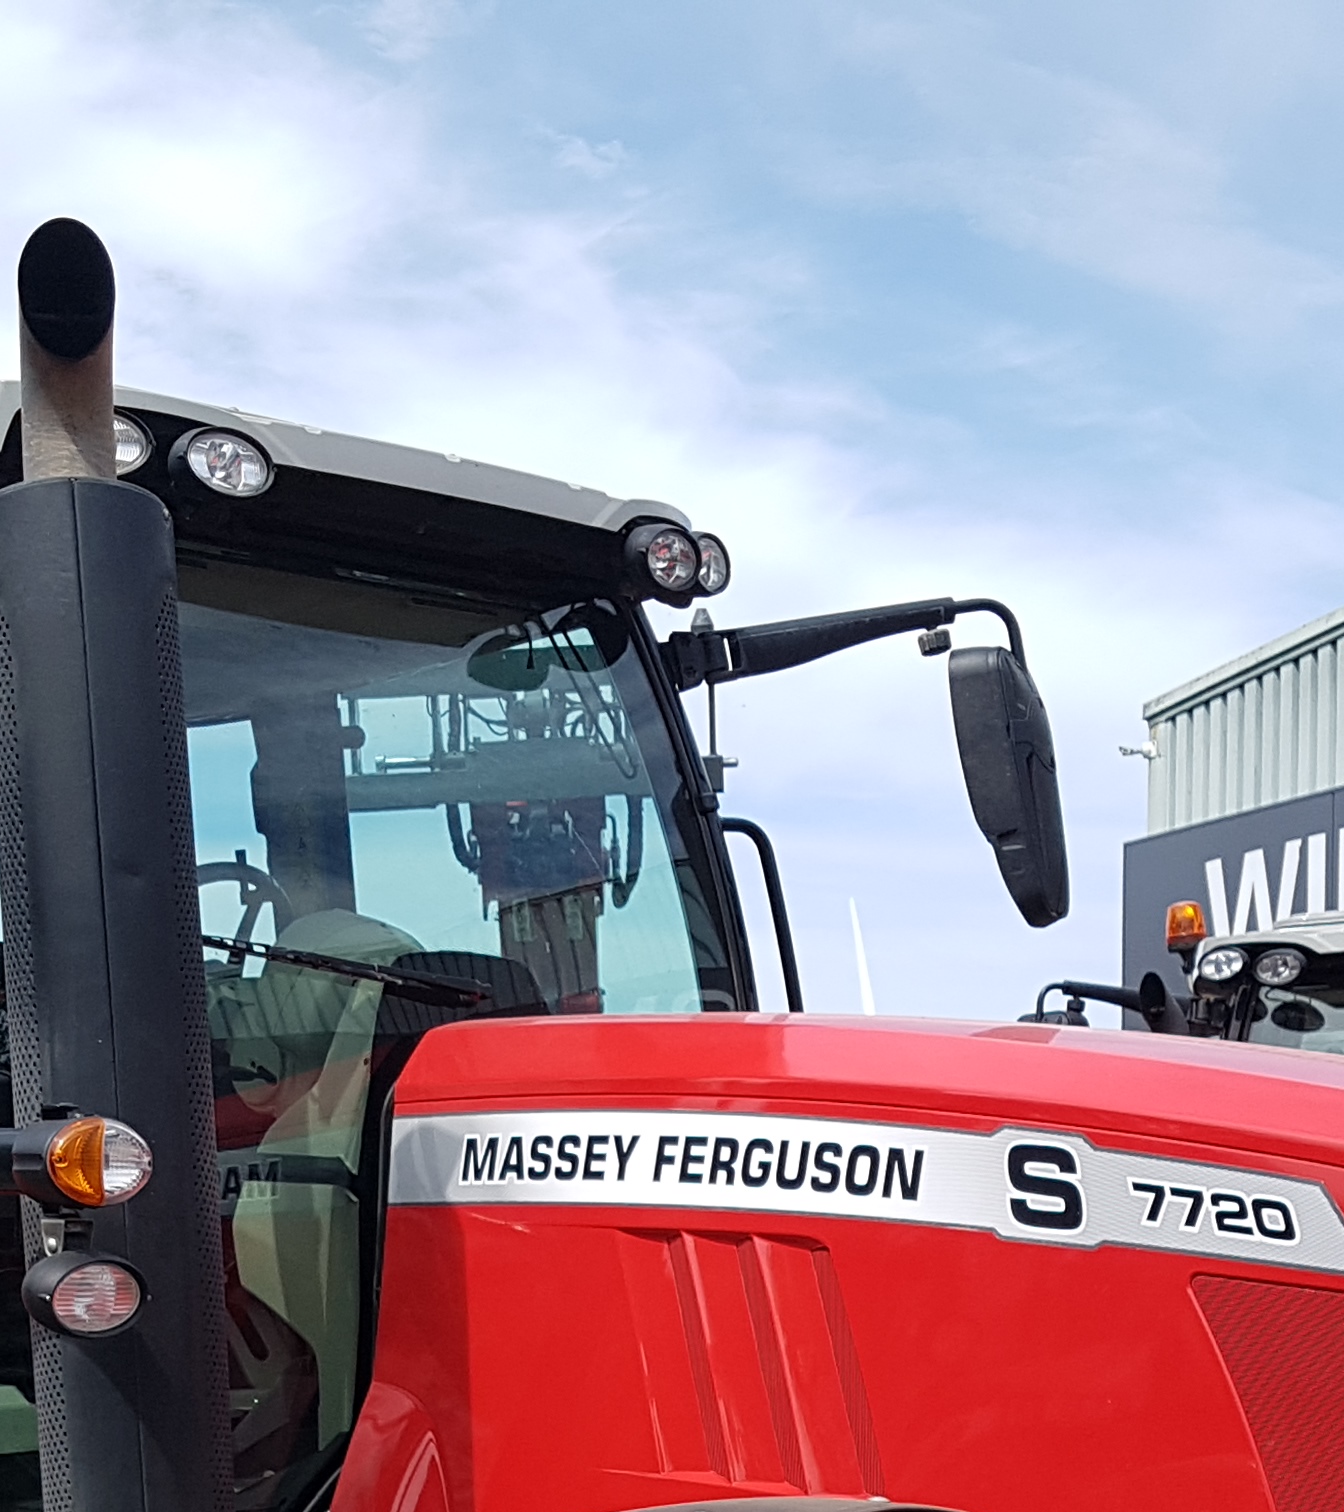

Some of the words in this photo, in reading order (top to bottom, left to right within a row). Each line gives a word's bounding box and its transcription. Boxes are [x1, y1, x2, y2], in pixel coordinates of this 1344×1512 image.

[459, 1134, 640, 1184] MASSEY
[652, 1135, 924, 1201] FERGUSON
[1006, 1143, 1084, 1232] S
[1130, 1180, 1299, 1242] 7720
